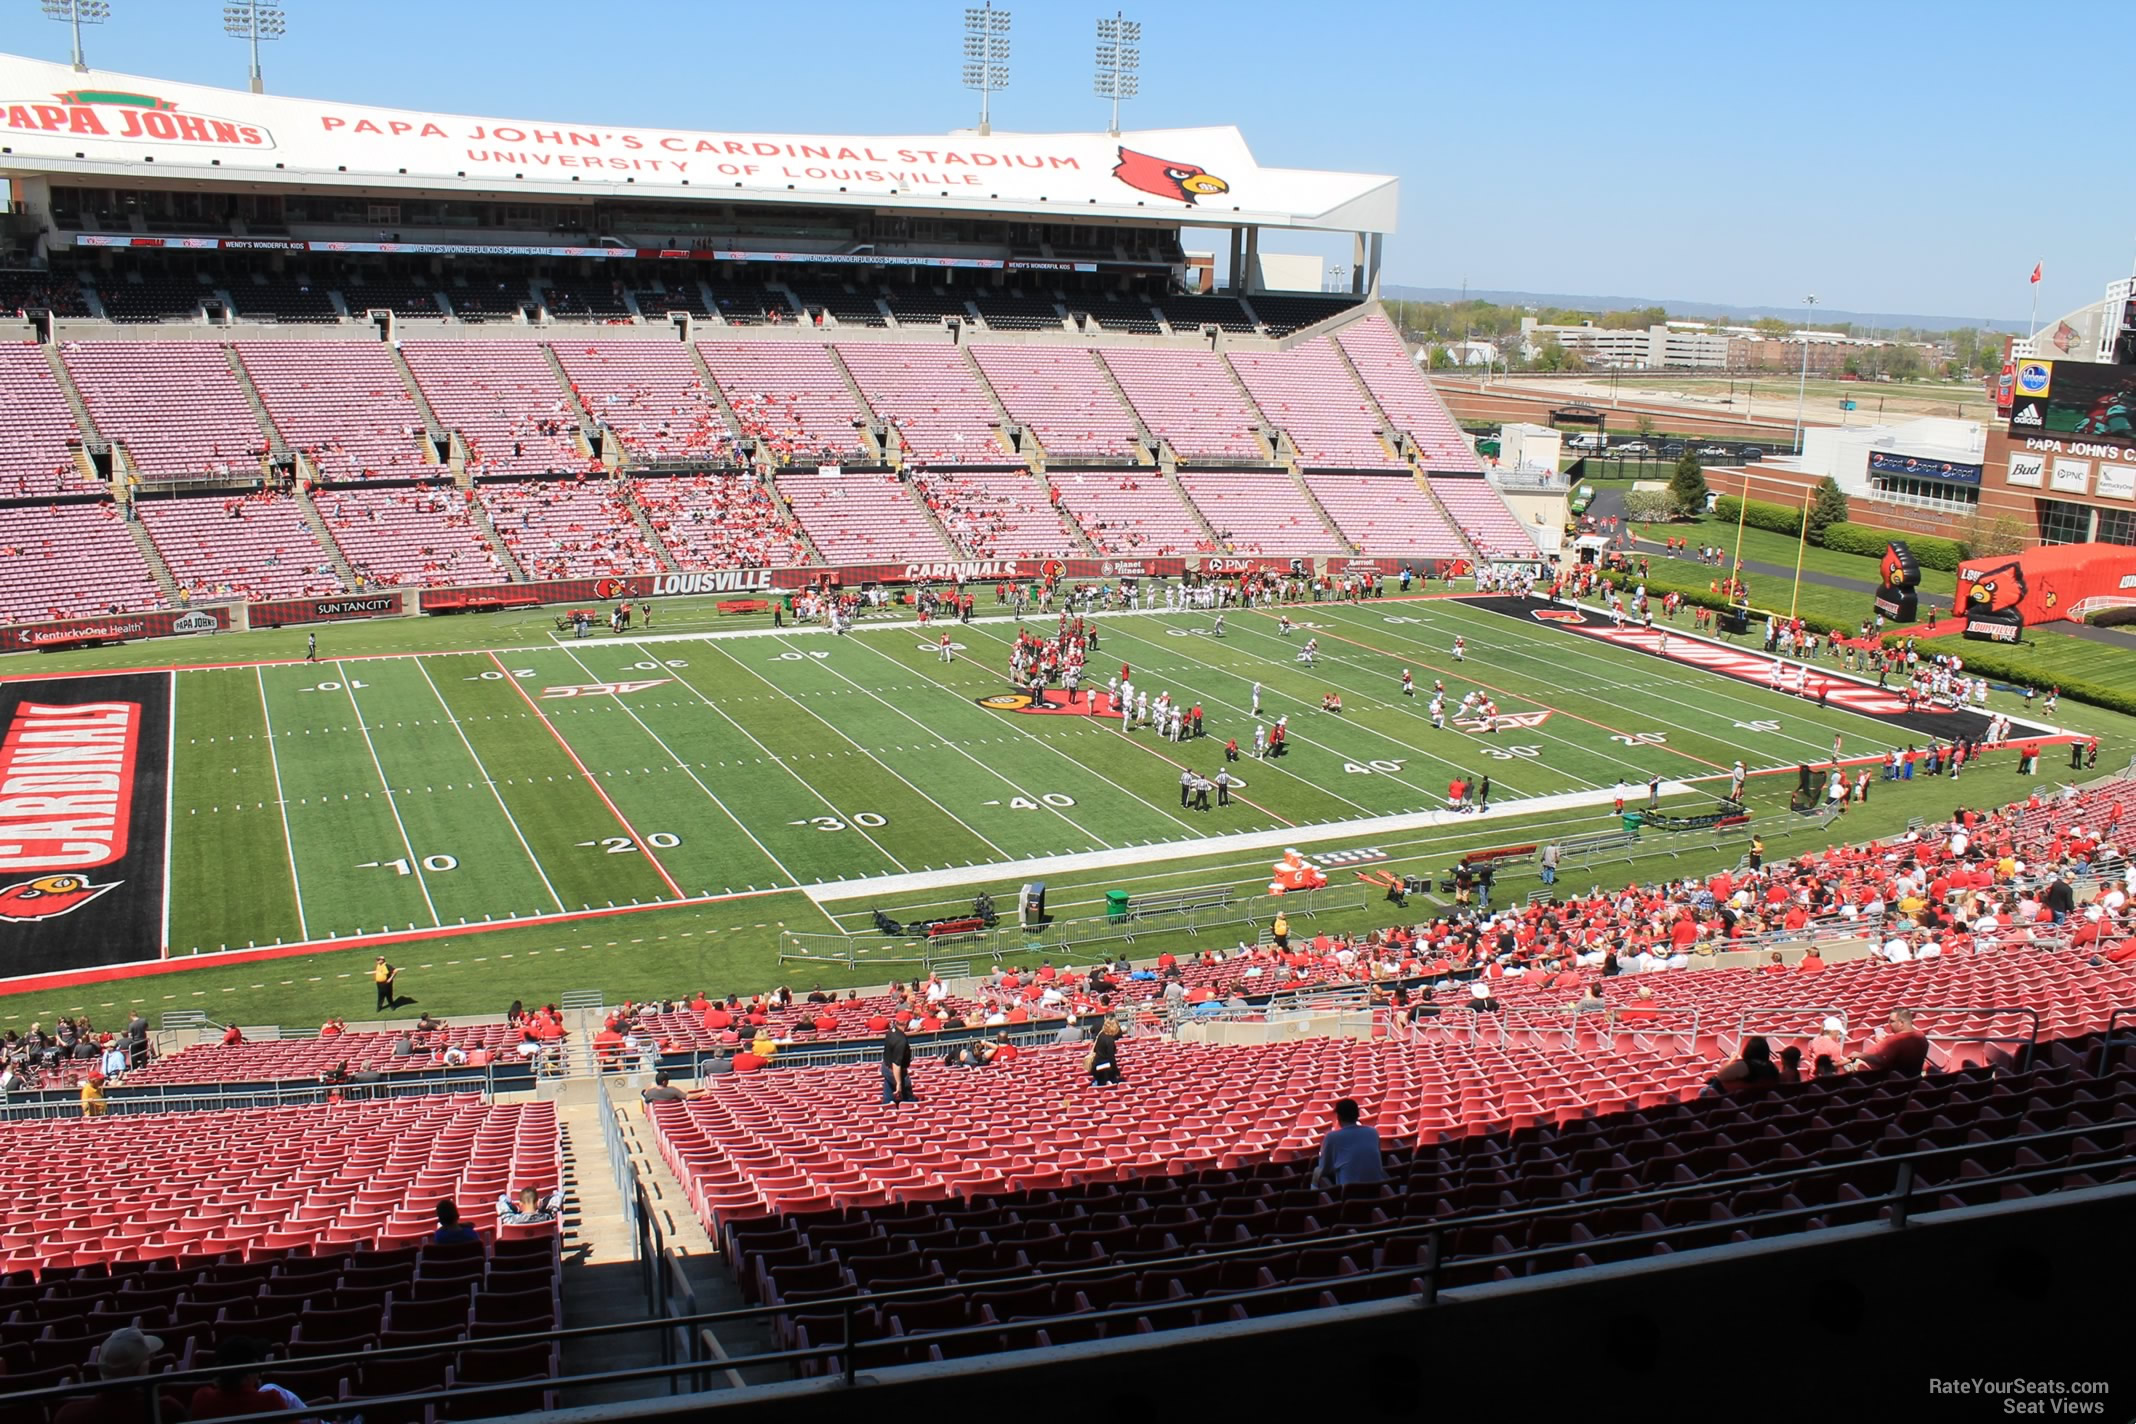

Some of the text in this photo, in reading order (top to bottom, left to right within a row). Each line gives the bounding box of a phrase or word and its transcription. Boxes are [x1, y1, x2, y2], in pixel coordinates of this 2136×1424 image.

[320, 116, 1081, 170] PAPA JOHN'S CARDINAL STADIUM
[467, 149, 983, 186] UNIVERSITY OF LOUISVILLE
[225, 241, 252, 249] WENDY'S
[253, 241, 289, 249] WONDERFUL
[413, 244, 552, 255] WENDY'S WONDERFUL KIDS SPRING GAME
[803, 254, 831, 263] WENDY'S
[832, 255, 868, 263] WONDERFUL
[869, 256, 884, 264] KIDS
[2023, 367, 2047, 388] Kroger
[2013, 416, 2042, 426] adidas
[2026, 438, 2062, 453] PAPA
[2067, 442, 2119, 460] JOHN'S
[1883, 458, 1904, 468] pepsi
[1916, 462, 1938, 473] pepsi
[2011, 463, 2041, 476] Bud
[1951, 467, 1974, 478] pepsi
[2100, 481, 2133, 491] KentuckyOne
[905, 561, 1016, 579] CARDINALS
[1115, 561, 1141, 571] planet
[1115, 567, 1145, 575] fitness
[1225, 559, 1254, 571] PNC
[653, 570, 772, 595] LOUISVILLE
[318, 599, 392, 615] SUN TAN CITY
[175, 620, 193, 631] PAPA
[1968, 621, 2017, 638] LOUISVILLE
[35, 627, 107, 641] KentuckyOne
[780, 651, 829, 660] 40
[633, 659, 689, 670] 30
[479, 668, 537, 681] 20
[315, 679, 370, 692] 10
[540, 679, 674, 699] ACC
[1733, 720, 1782, 733] 10
[1610, 731, 1667, 747] 20
[1480, 745, 1541, 760] 30
[1344, 759, 1402, 775] 40
[0, 703, 130, 868] CARDINALS
[1009, 793, 1077, 811] 40
[811, 812, 888, 832] 30
[601, 832, 682, 854] 20
[384, 853, 459, 876] 10
